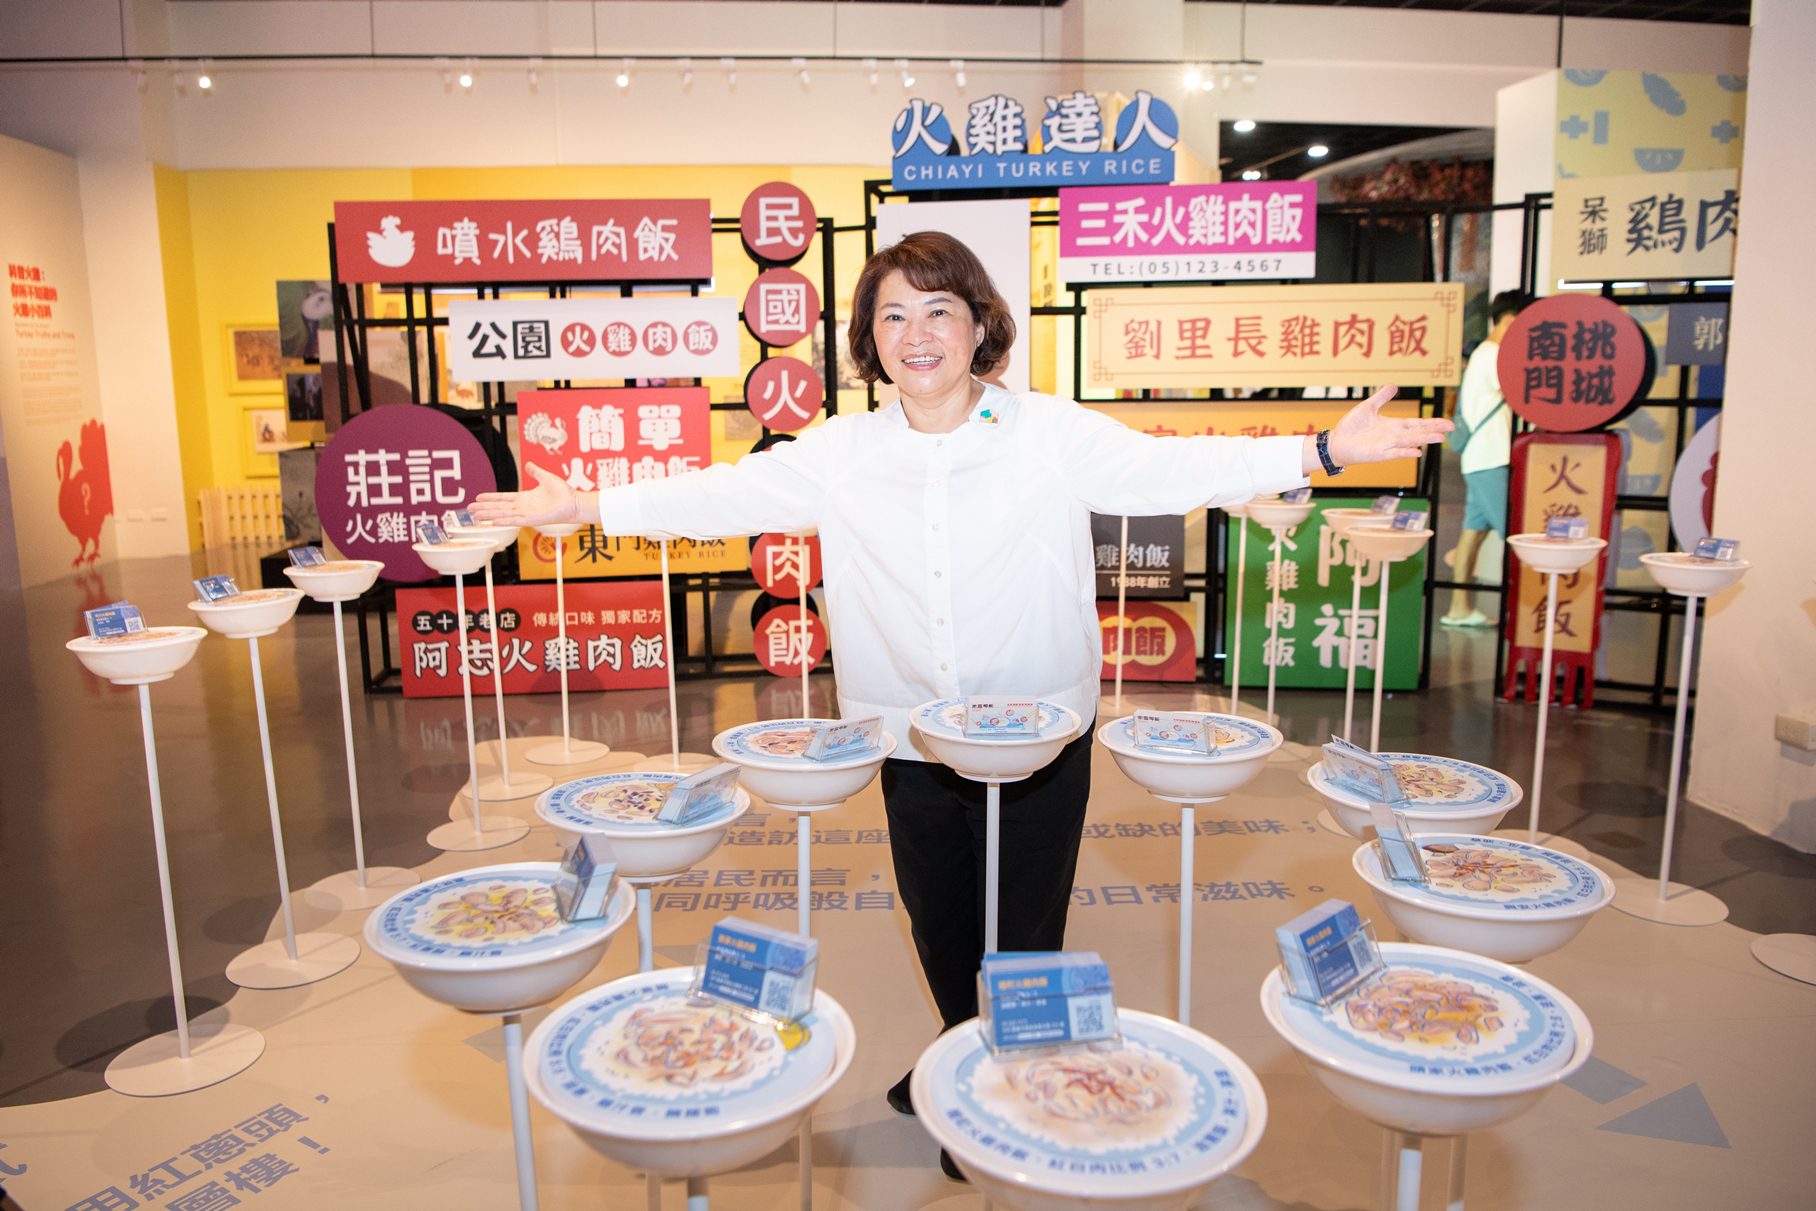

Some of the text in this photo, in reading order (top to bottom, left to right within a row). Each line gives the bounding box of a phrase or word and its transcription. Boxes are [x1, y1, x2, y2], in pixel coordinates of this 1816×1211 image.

[893, 90, 1178, 158] 火雞達人
[903, 157, 1163, 182] CHIAYI TURKEY RICE
[1075, 193, 1304, 248] 三禾火雞肉飯
[1090, 258, 1284, 277] TEL:(05)123-4567
[1123, 313, 1430, 361] 劉里長雞肉飯
[576, 404, 684, 453] 簡單
[755, 197, 816, 667] 民國火肉飯
[344, 449, 466, 507] 莊記
[644, 551, 691, 561] TUKEY
